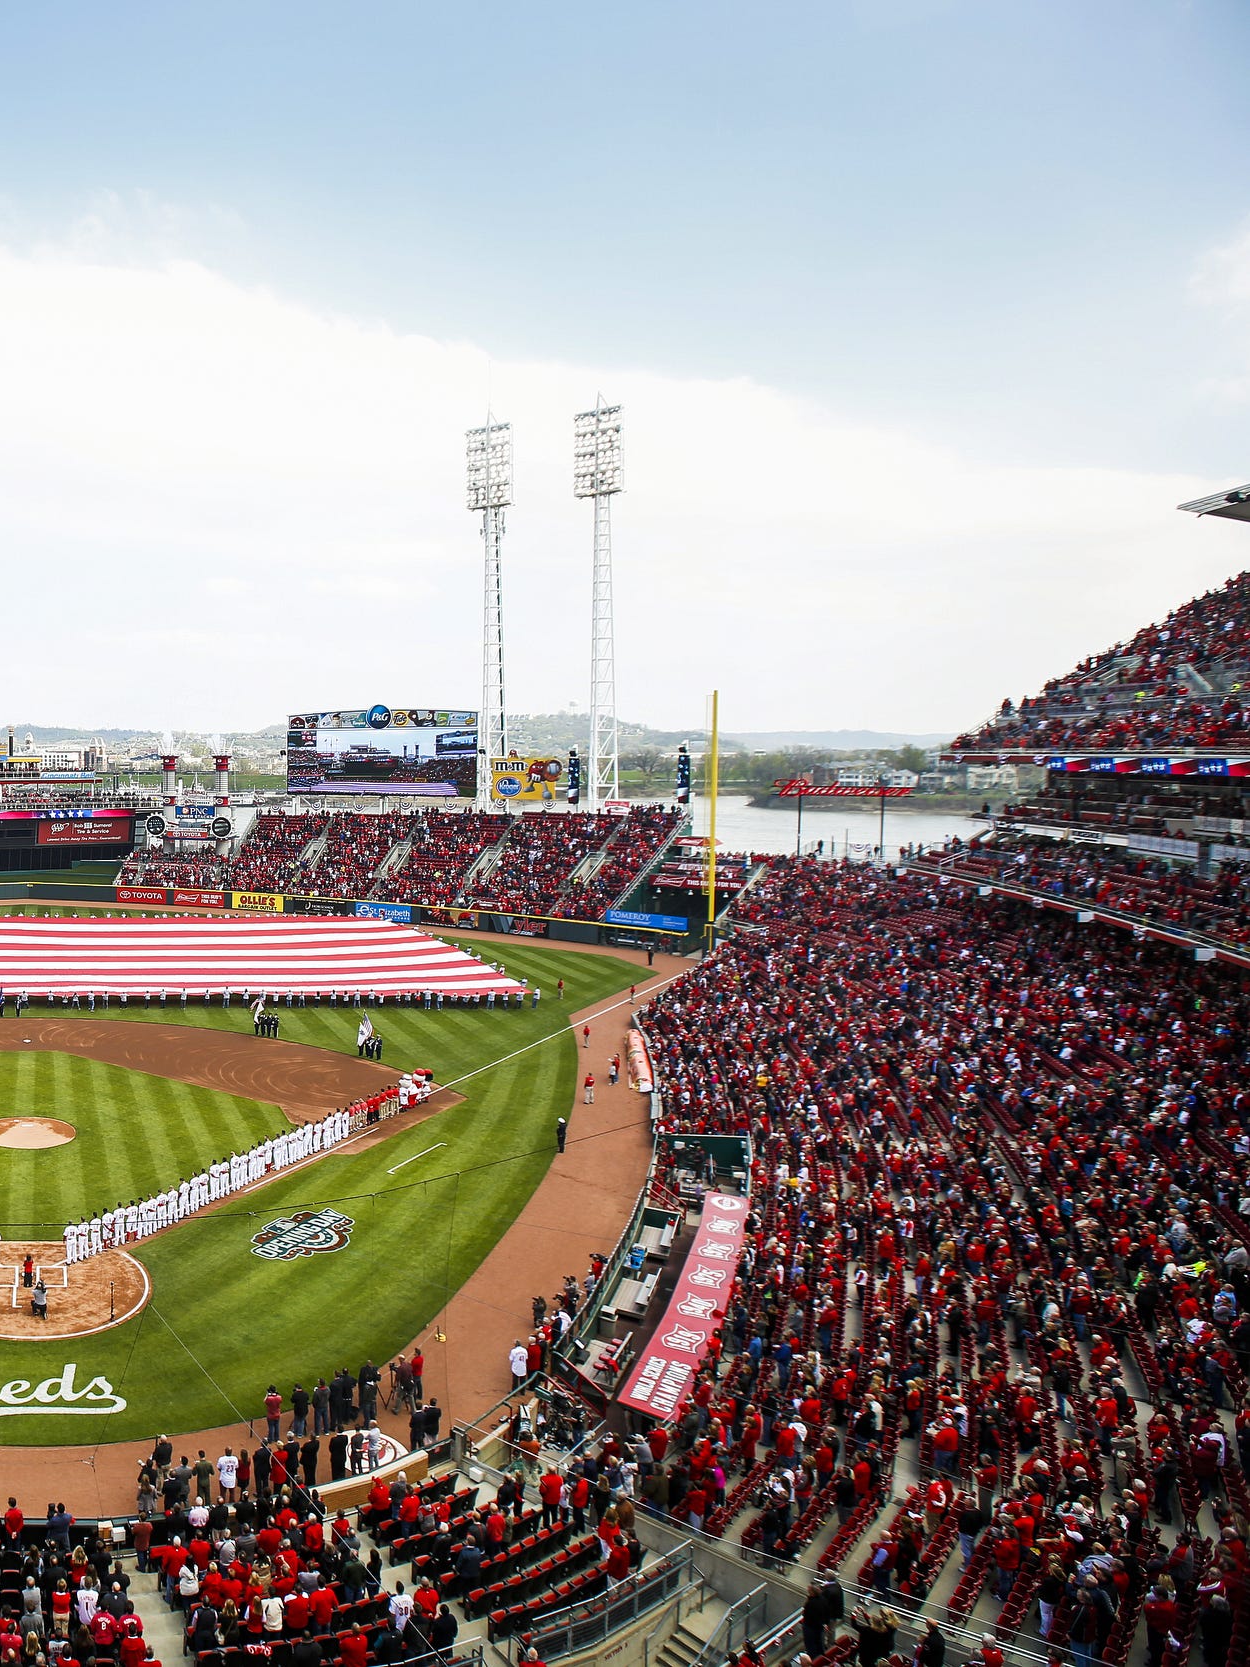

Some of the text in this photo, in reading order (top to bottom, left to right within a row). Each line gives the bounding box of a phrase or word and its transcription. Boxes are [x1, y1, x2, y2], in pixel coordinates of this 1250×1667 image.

[372, 712, 389, 722] P&G
[499, 780, 519, 790] Kroger
[773, 778, 914, 797] Budweiser
[190, 807, 208, 815] PNC
[132, 891, 163, 900] TOYOTA
[490, 913, 547, 935] Wyler
[610, 910, 650, 920] POMEROY
[254, 1210, 345, 1258] OPENING DAY
[692, 1267, 724, 1288] 1975
[681, 1297, 713, 1318] 1940
[665, 1328, 702, 1351] 1919
[630, 1355, 668, 1402] WORLD SERIES
[650, 1360, 692, 1414] CHAMPIONS
[398, 1606, 409, 1617] 30
